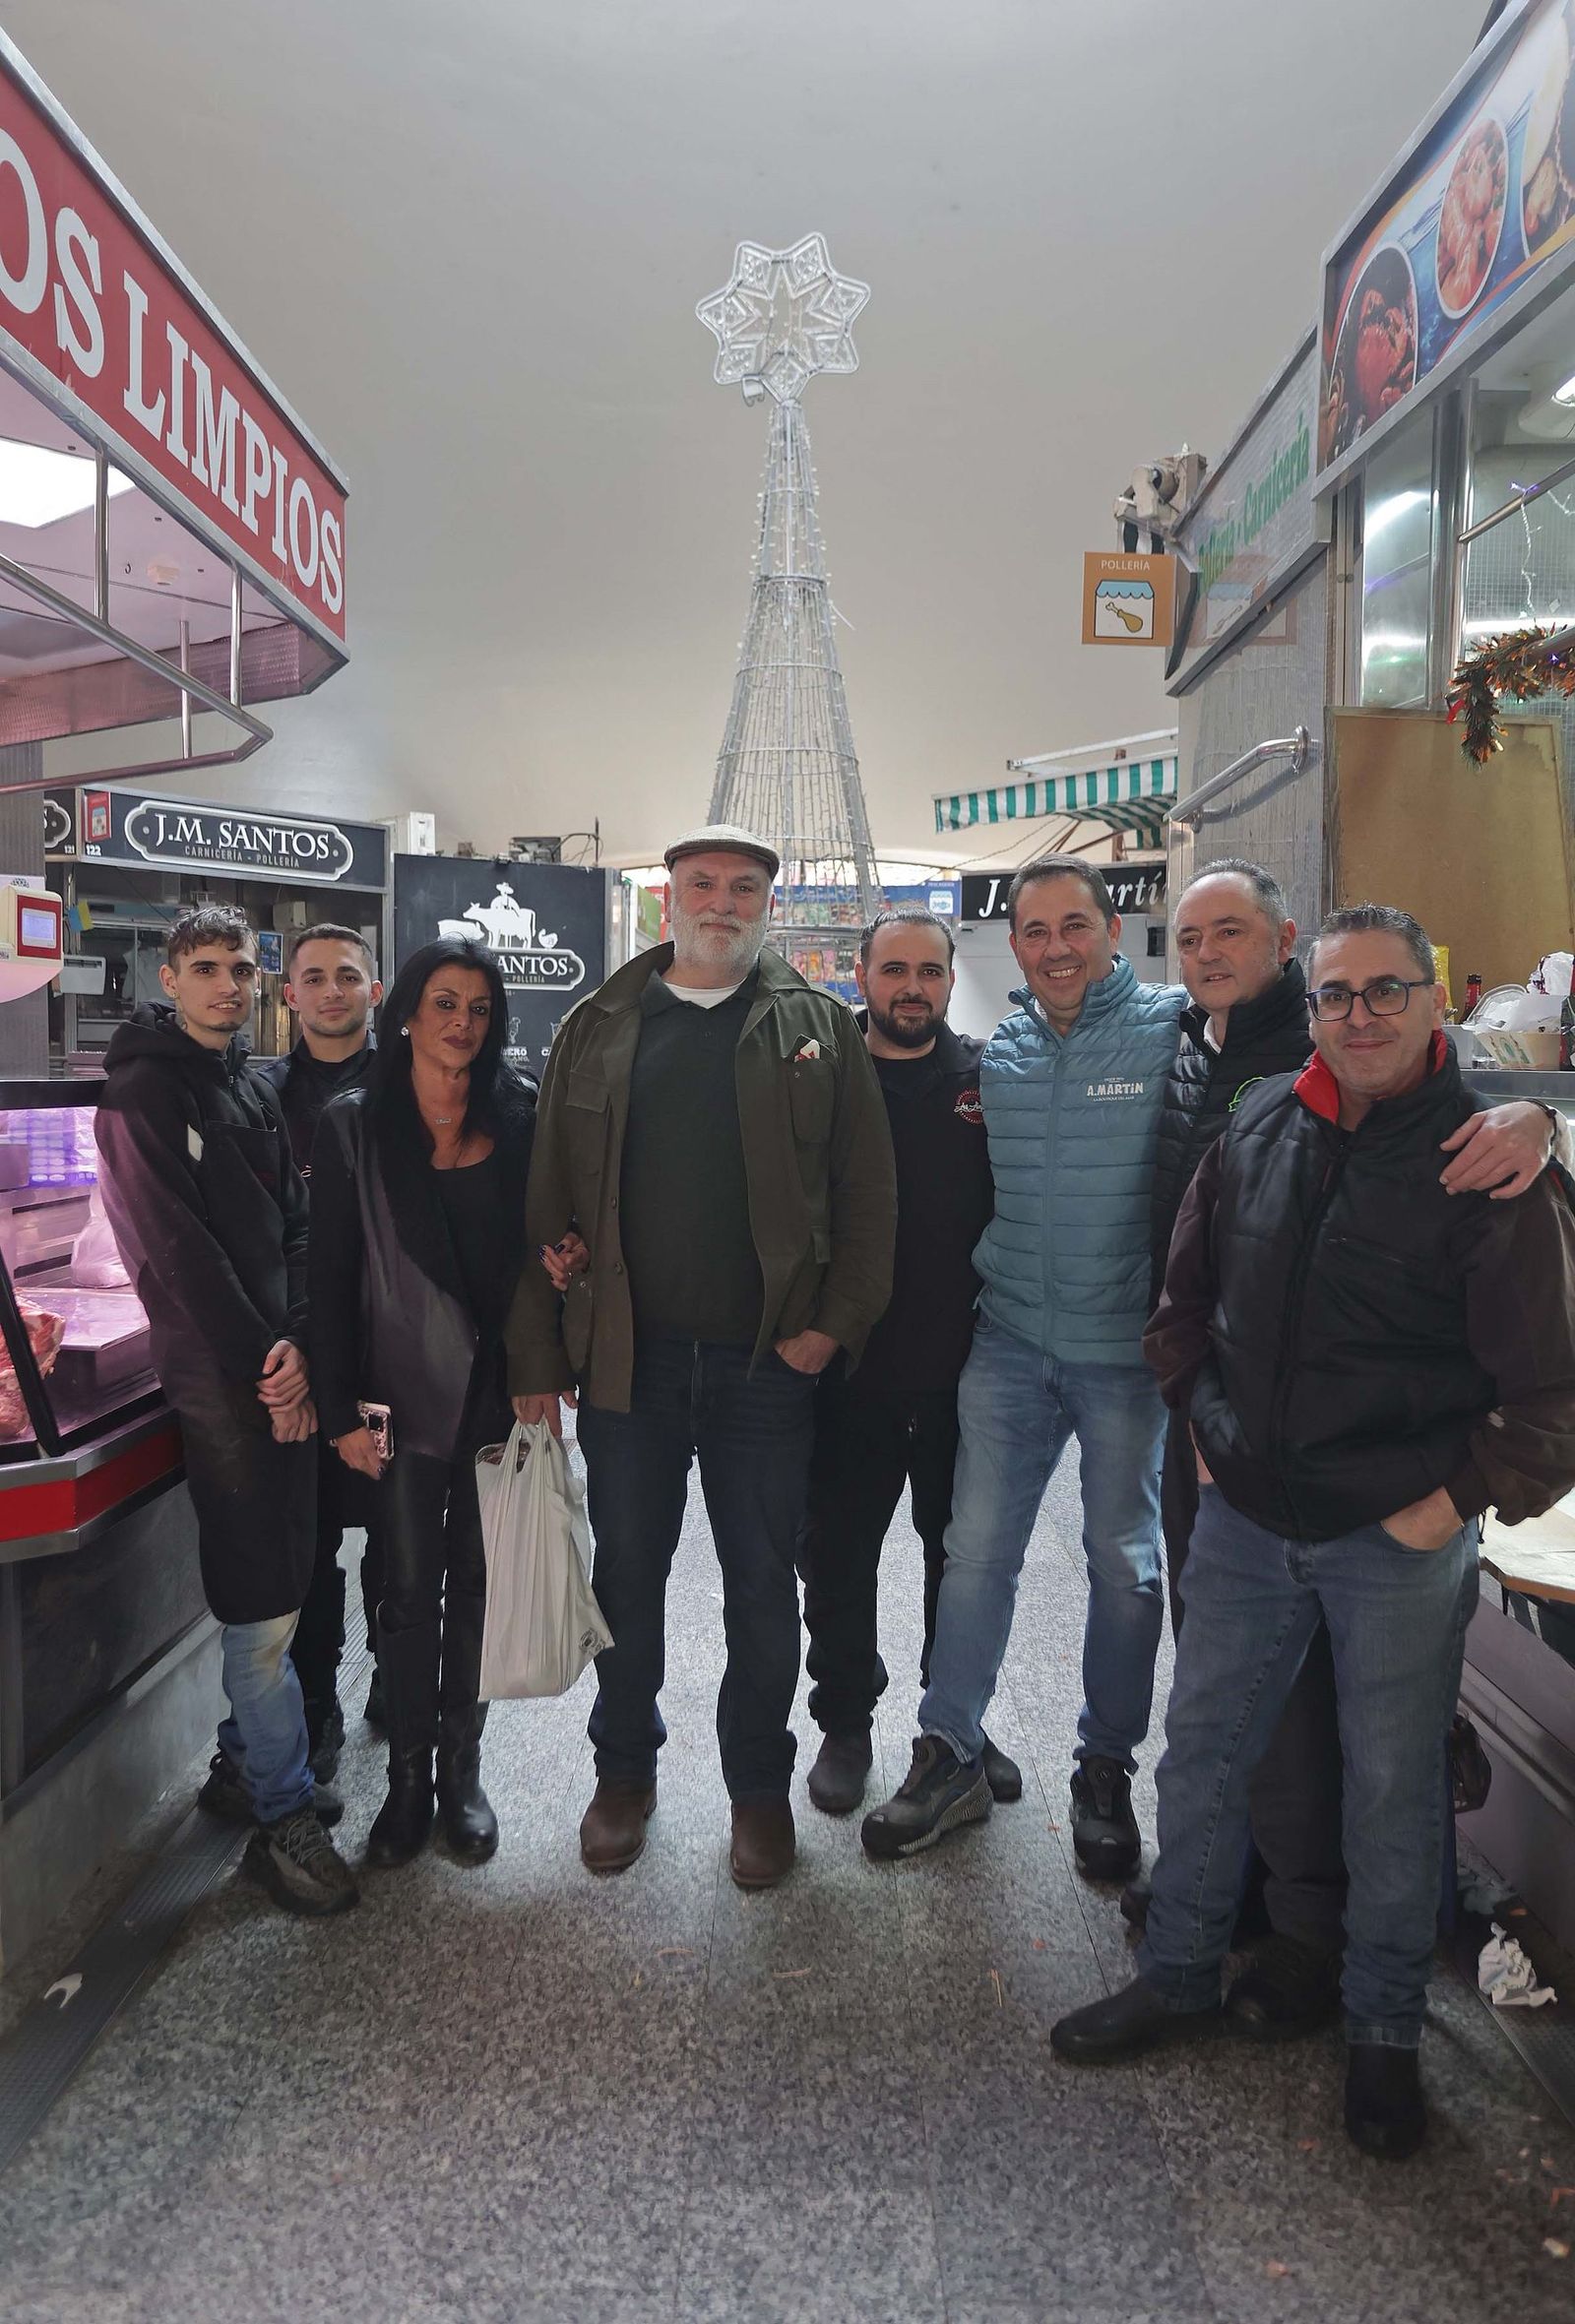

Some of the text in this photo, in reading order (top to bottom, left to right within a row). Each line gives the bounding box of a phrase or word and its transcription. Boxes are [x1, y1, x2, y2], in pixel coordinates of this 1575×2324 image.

[123, 270, 343, 614] LIMPIOS
[1244, 410, 1310, 545] Carnicería
[1101, 559, 1151, 571] POLLERÍA
[155, 813, 330, 860] J.M. SANTOS
[64, 845, 76, 854] 121
[86, 844, 102, 856] 122
[184, 846, 243, 862] CARNICERÍA
[256, 854, 300, 868] POLLERÍA
[494, 954, 568, 976] ANTOS
